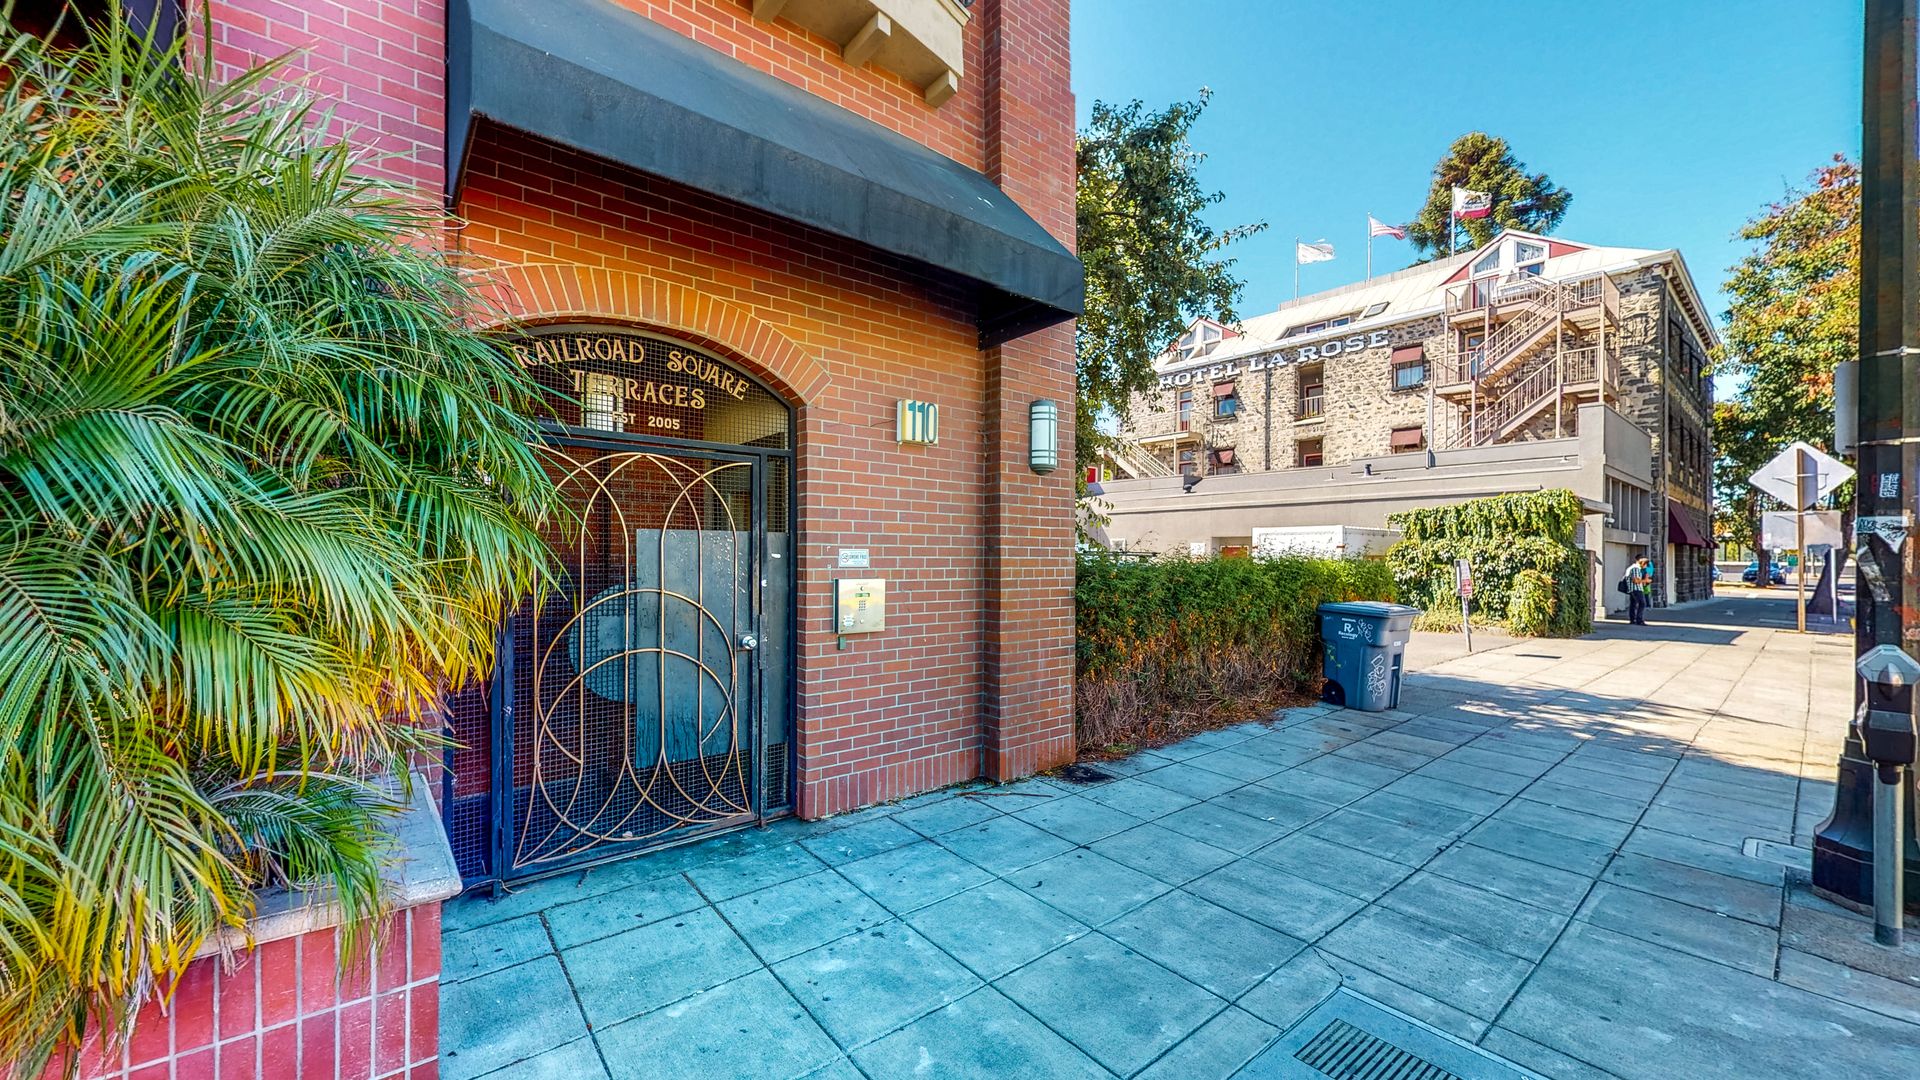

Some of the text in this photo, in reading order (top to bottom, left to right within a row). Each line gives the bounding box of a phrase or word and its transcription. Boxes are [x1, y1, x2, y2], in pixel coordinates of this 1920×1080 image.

[512, 338, 750, 401] RAILROAD SQUARE
[1160, 329, 1390, 388] HOTEL LA ROSE
[570, 368, 706, 409] TERRACES
[612, 411, 680, 430] EST 2005
[908, 400, 938, 443] 110
